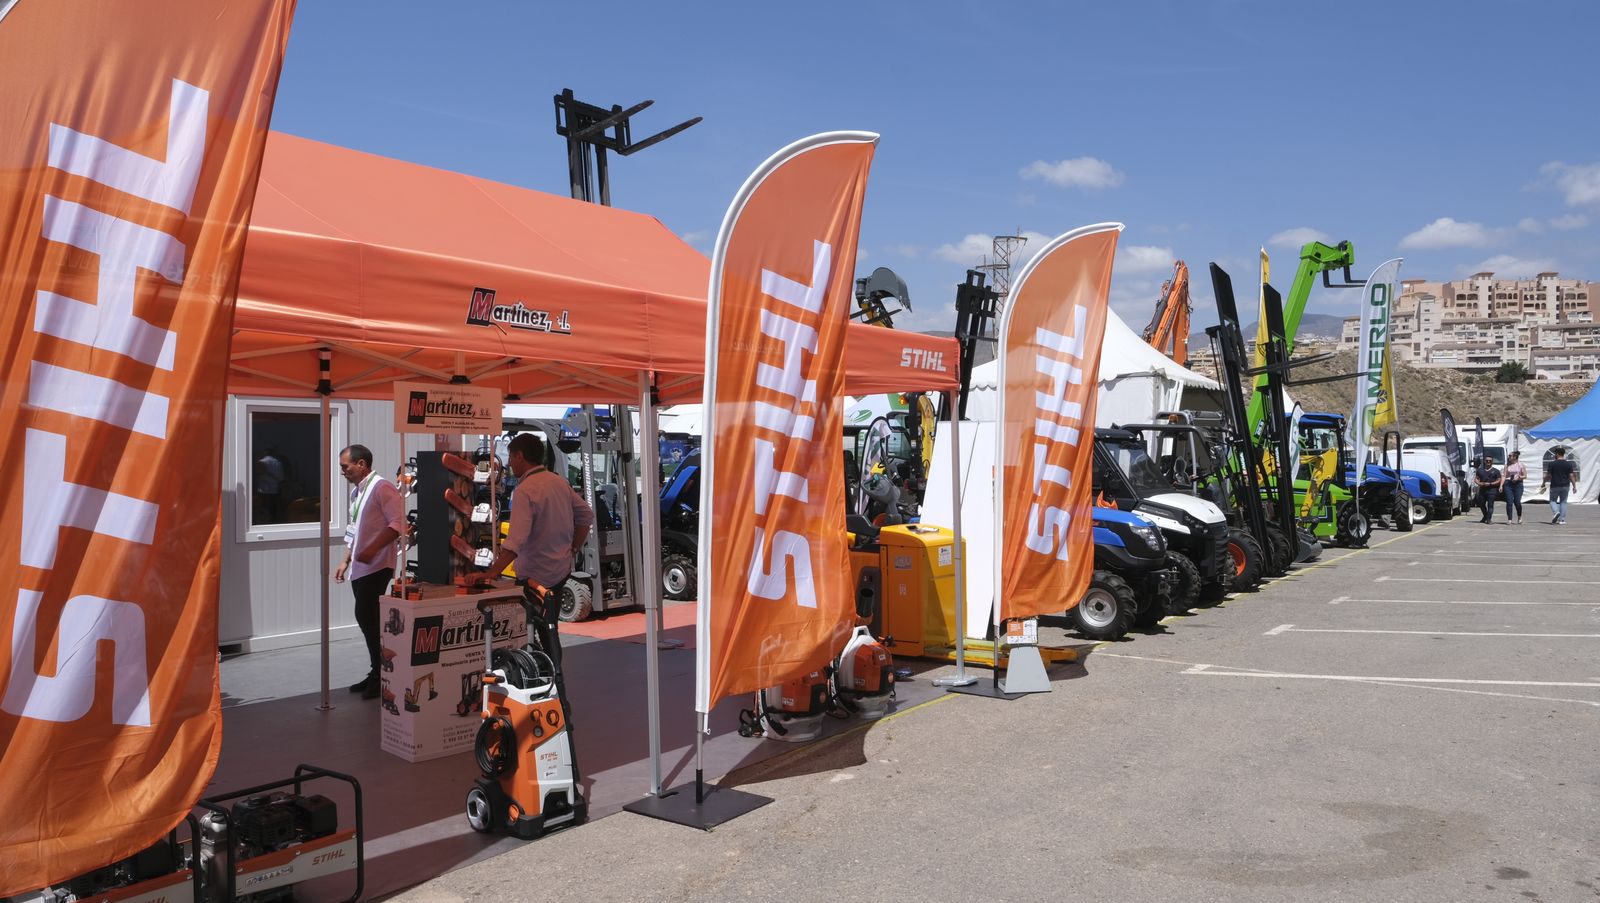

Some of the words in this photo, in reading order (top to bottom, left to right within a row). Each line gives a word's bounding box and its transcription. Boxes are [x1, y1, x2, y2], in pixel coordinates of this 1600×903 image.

[900, 347, 947, 372] STIHL
[1367, 282, 1387, 399] MERLO
[2, 78, 209, 727] STIHL
[748, 239, 832, 609] STIHL
[1025, 304, 1087, 561] STIHL
[584, 452, 593, 508] UNGHEINRICH
[540, 752, 558, 761] STIHL
[312, 849, 346, 866] STIHL
